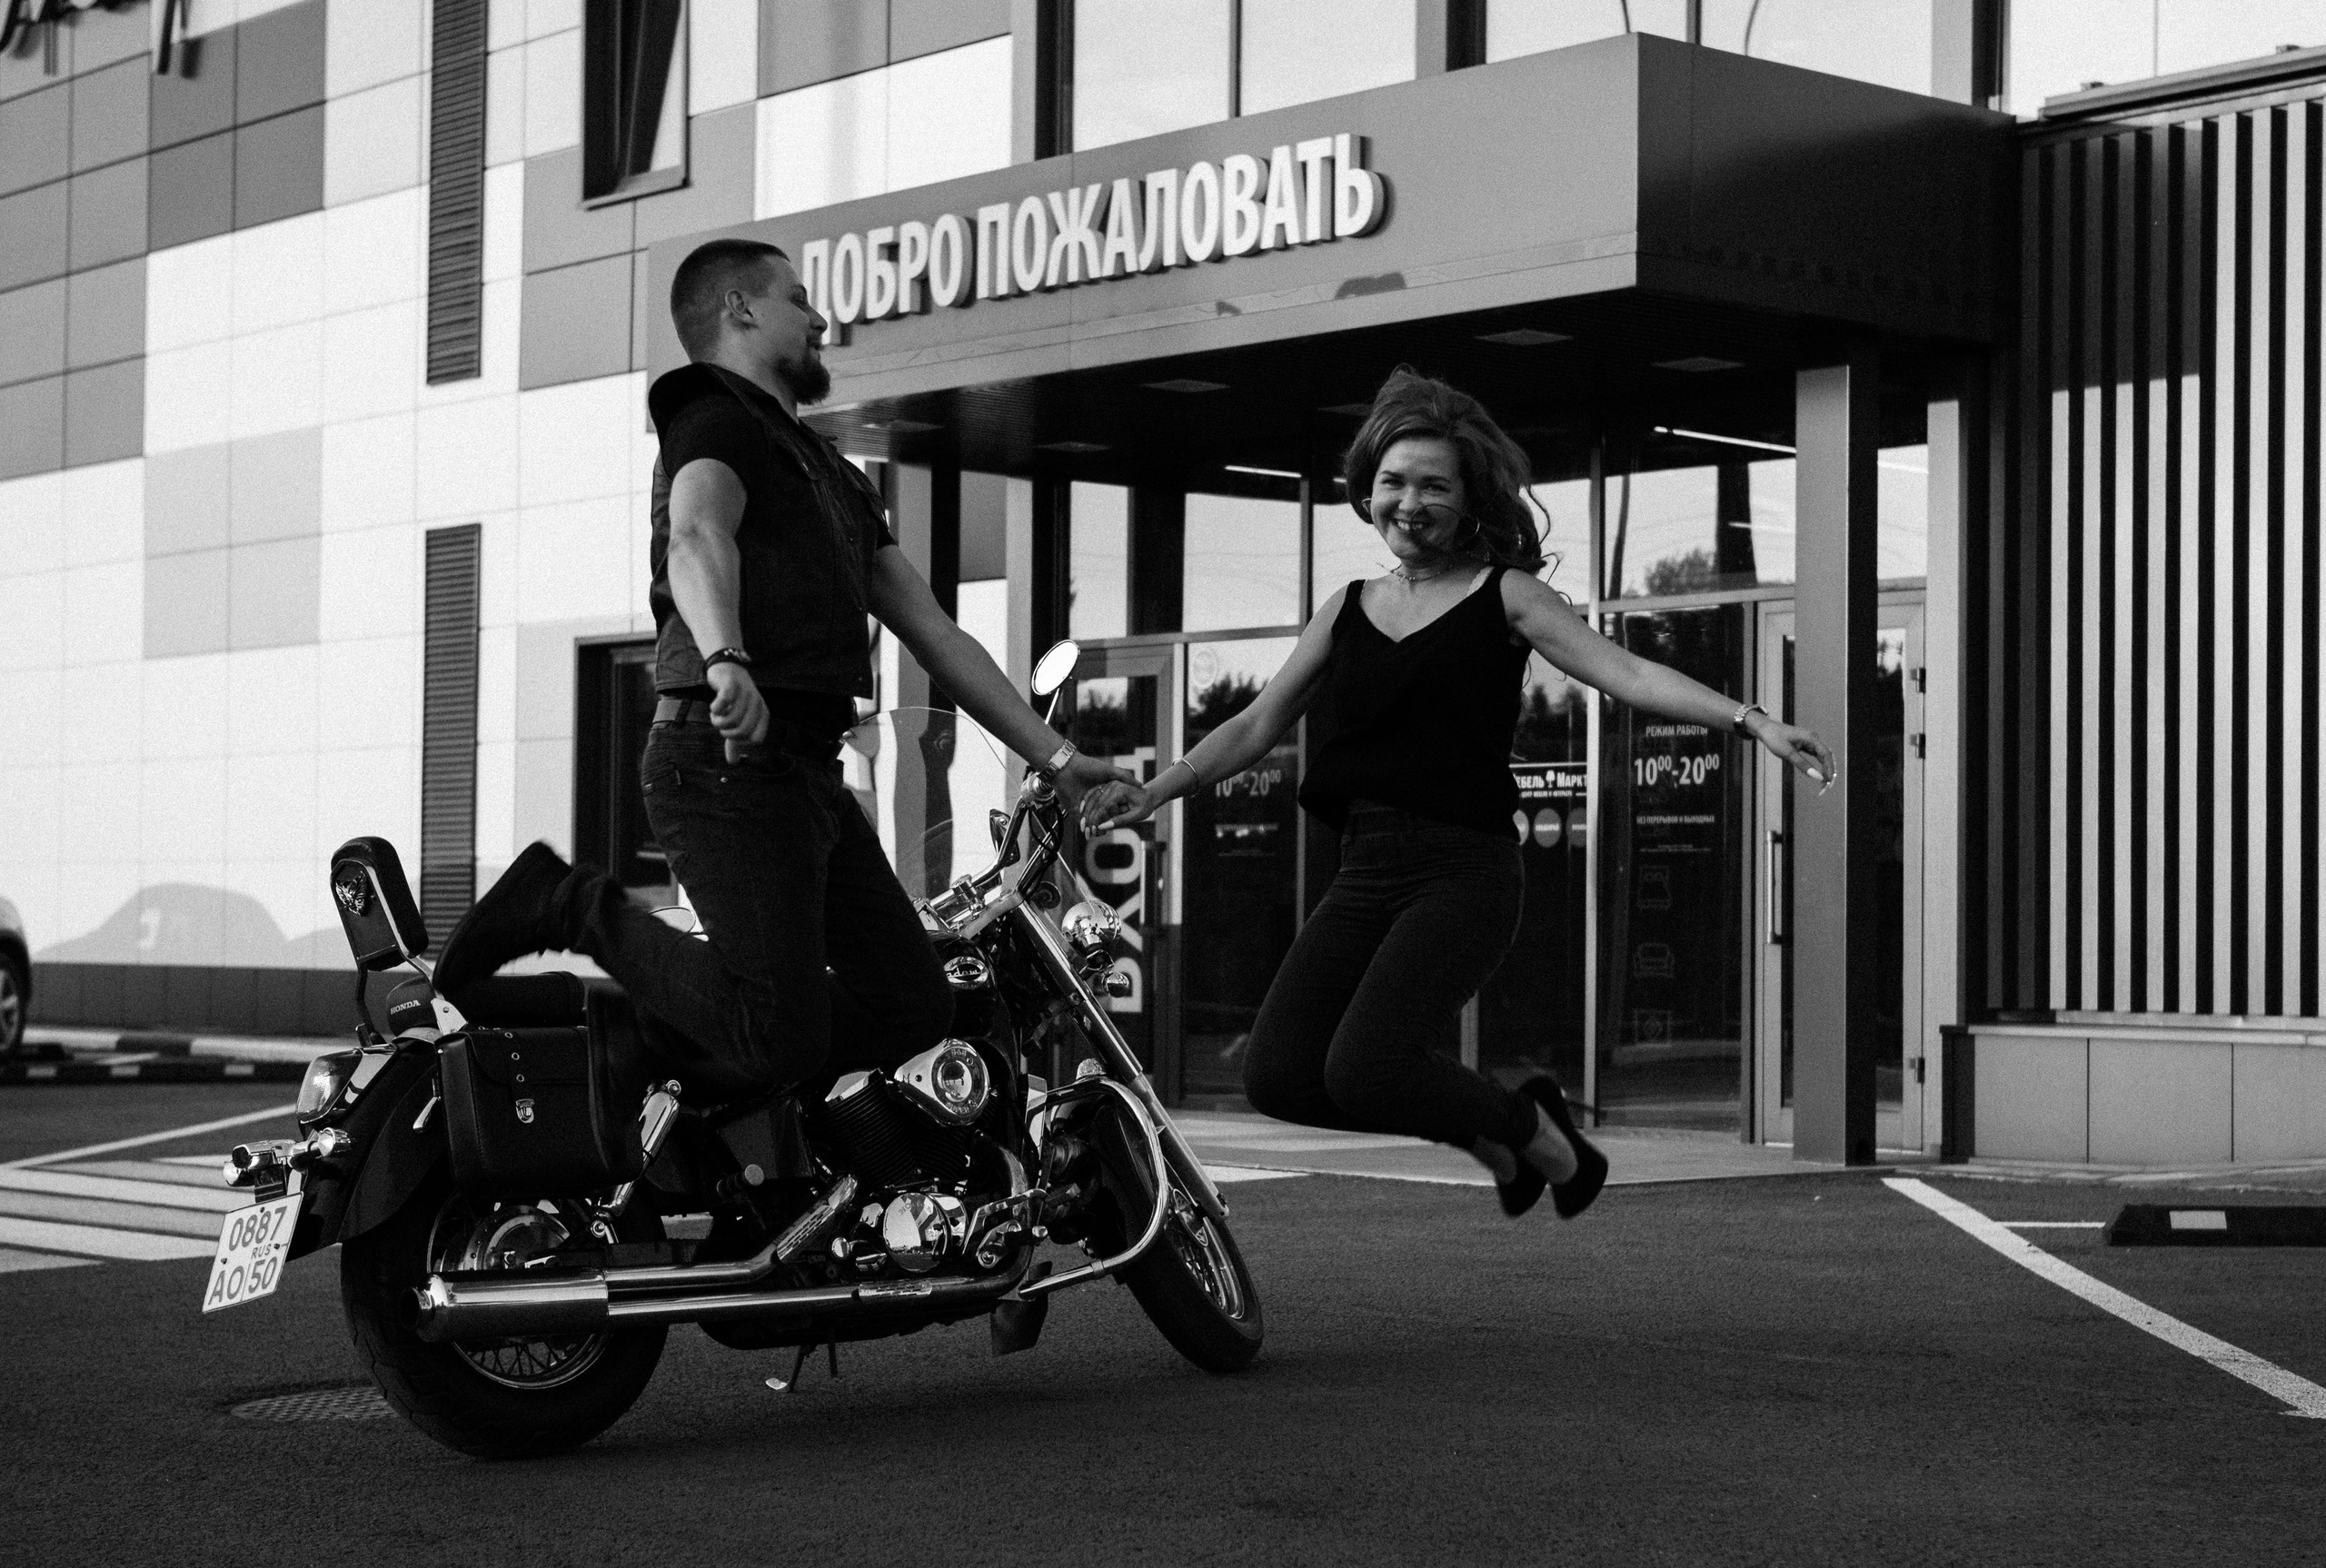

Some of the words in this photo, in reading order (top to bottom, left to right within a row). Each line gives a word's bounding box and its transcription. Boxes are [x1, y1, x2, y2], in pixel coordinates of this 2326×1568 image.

[802, 213, 970, 344] ДОБРО
[978, 134, 1383, 300] ПОЖАЛОВАТЬ
[1645, 725, 1675, 738] РЕЖИМ
[1676, 724, 1708, 736] РАБОТЫ
[1513, 773, 1545, 789] ЕБЕЛЬ
[946, 967, 981, 978] adow
[390, 999, 421, 1015] HONDA
[229, 1206, 287, 1251] 0887
[251, 1244, 272, 1260] RUS
[248, 1256, 277, 1294] 50
